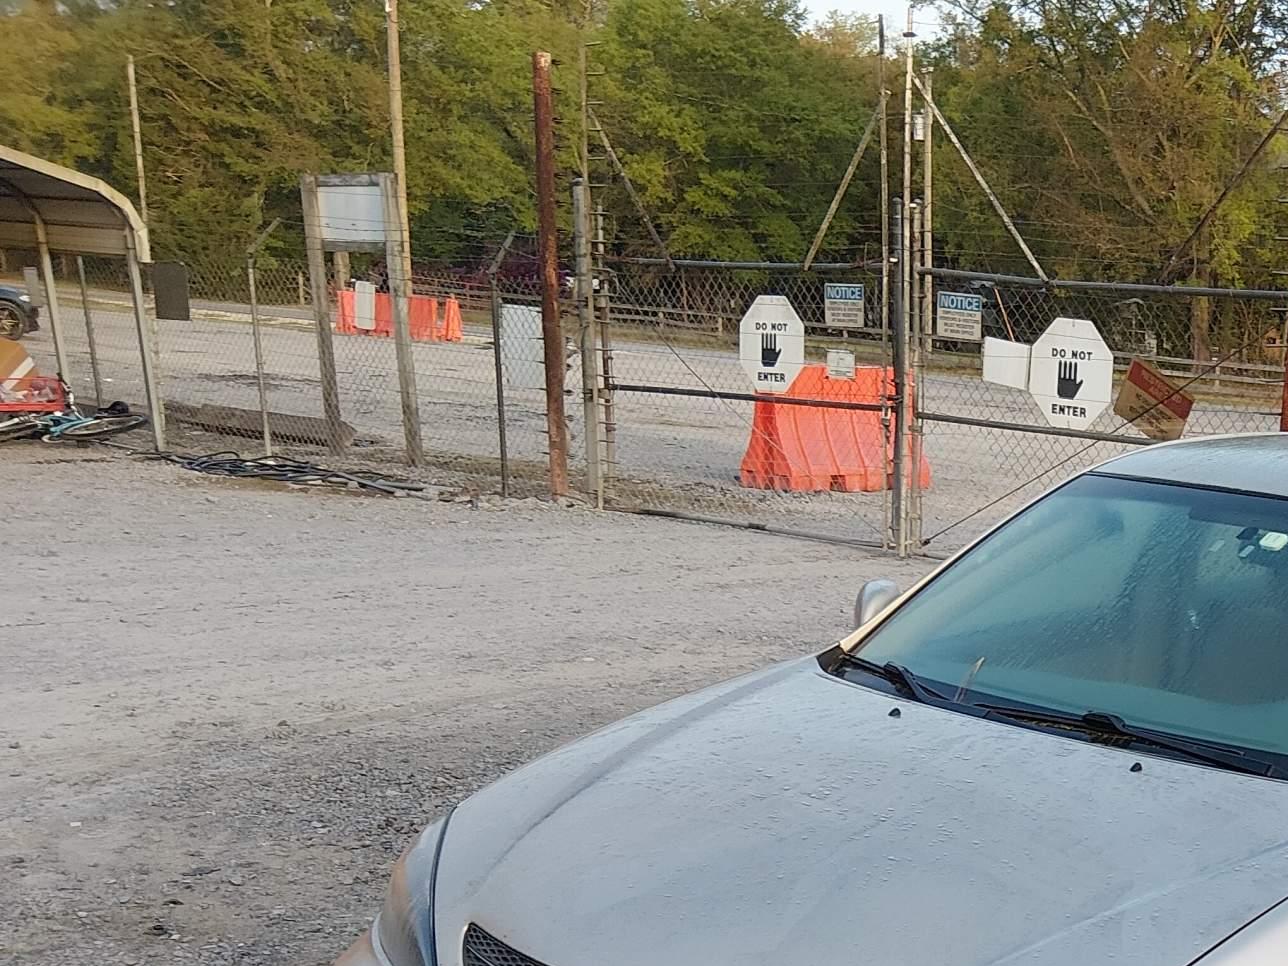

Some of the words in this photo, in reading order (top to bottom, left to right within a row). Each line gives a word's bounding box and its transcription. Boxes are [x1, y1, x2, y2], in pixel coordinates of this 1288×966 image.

[827, 286, 861, 299] NOTICE
[940, 295, 980, 311] NOTICE
[755, 322, 767, 331] DO
[771, 322, 788, 332] NOT
[1051, 347, 1067, 358] DO
[1071, 350, 1093, 361] NOT
[757, 371, 786, 383] ENTER
[1051, 403, 1087, 418] ENTER
